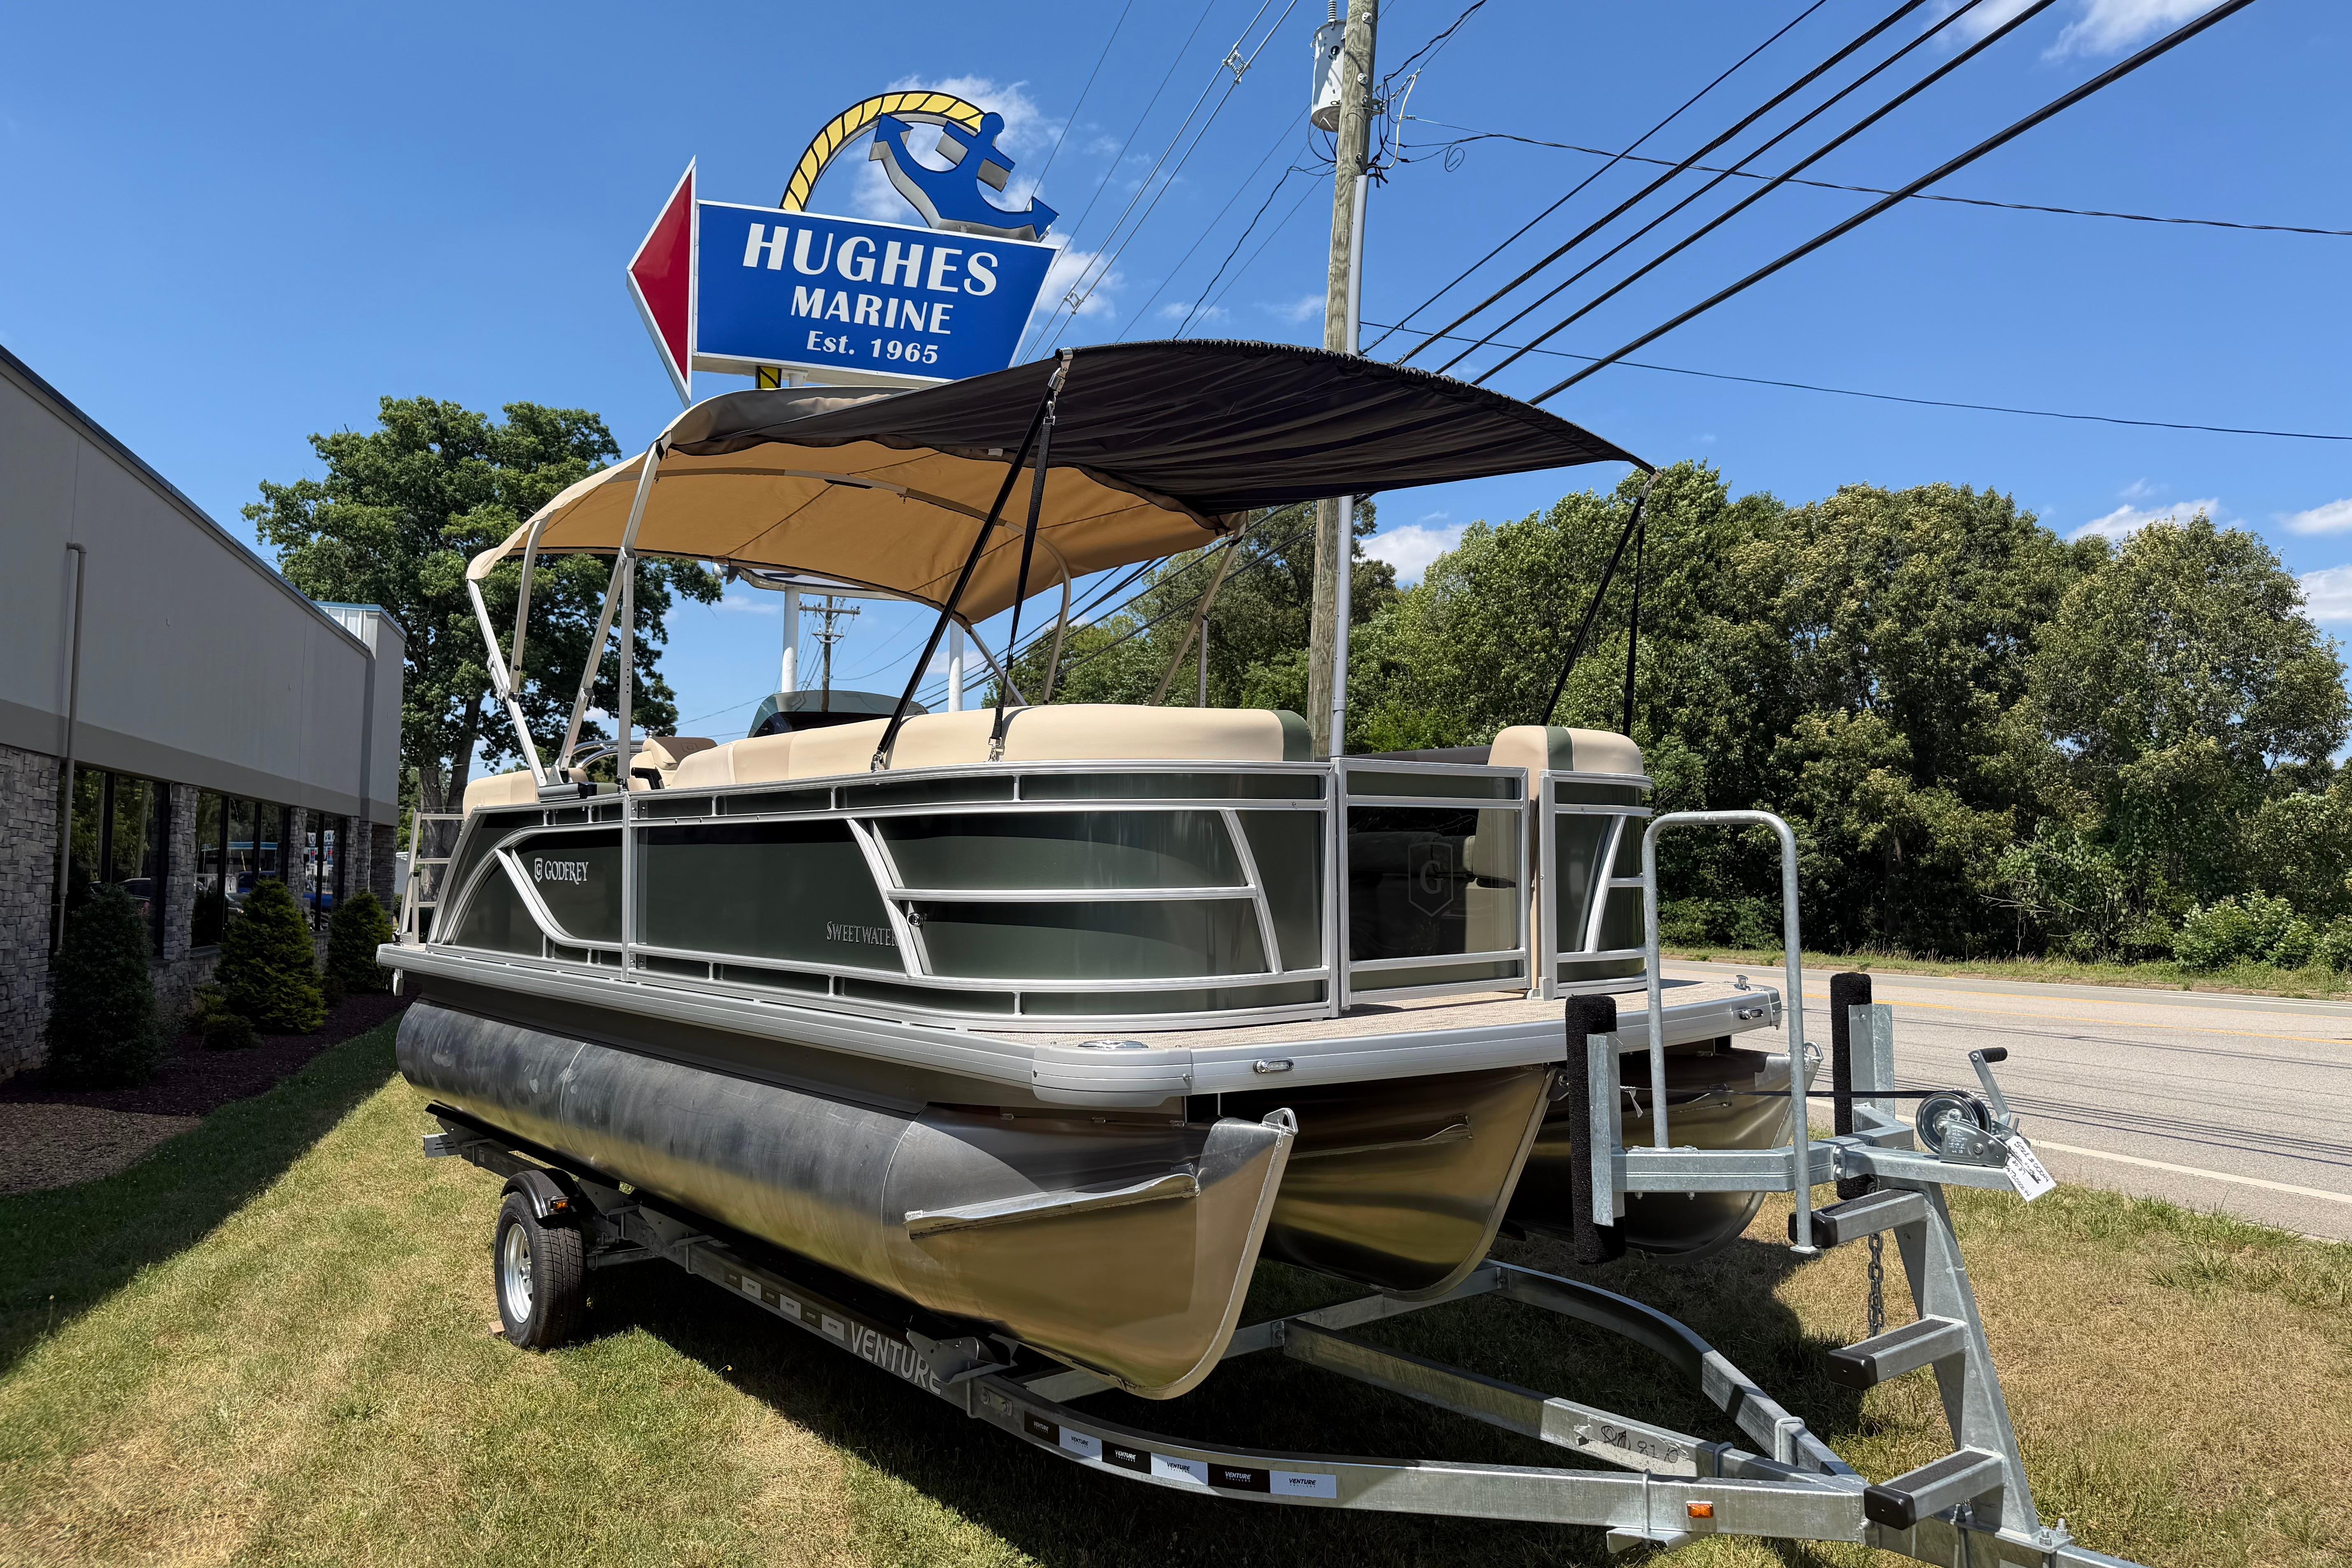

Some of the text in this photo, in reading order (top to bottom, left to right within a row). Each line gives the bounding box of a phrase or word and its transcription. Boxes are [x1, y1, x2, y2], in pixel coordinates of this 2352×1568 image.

[743, 223, 998, 296] HUGHES
[791, 285, 954, 334] MARINE
[806, 330, 938, 364] Est. 1965
[545, 861, 589, 885] GODFREY
[1420, 860, 1444, 894] G
[851, 1321, 942, 1395] VENTURE
[1033, 1420, 1049, 1432] VENTURE
[1071, 1435, 1089, 1446] VENTURE
[1115, 1449, 1136, 1460] VENTURE
[1167, 1462, 1190, 1471] VENTURE
[1225, 1471, 1251, 1480] VENTURE
